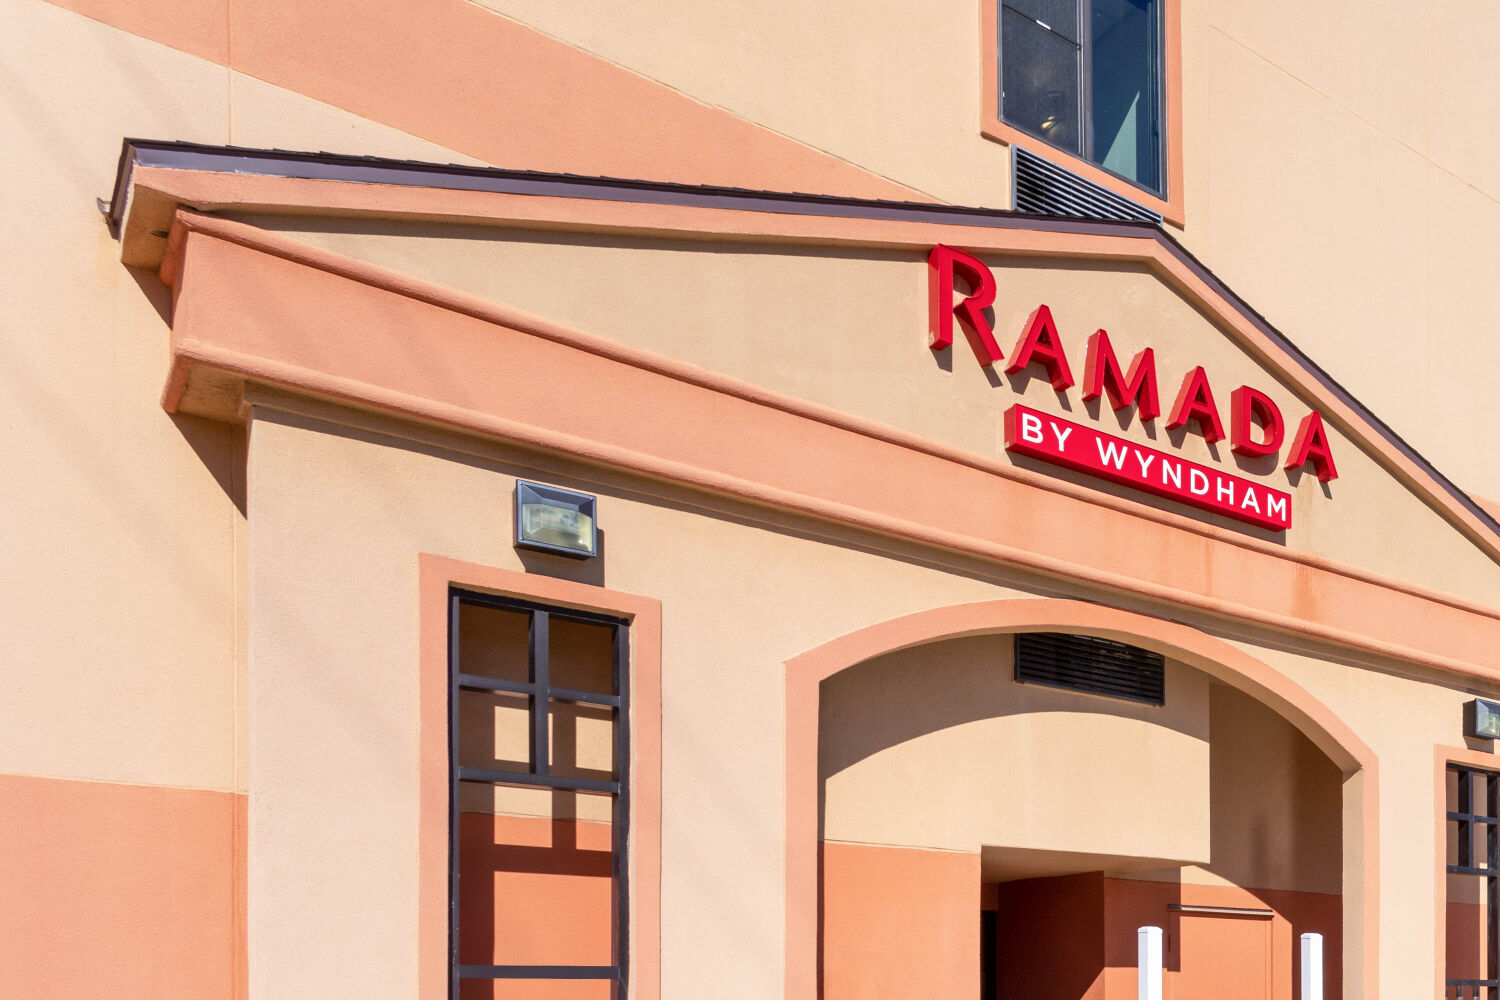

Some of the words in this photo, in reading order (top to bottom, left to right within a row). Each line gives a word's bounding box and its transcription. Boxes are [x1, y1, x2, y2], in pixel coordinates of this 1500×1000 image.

[928, 243, 1339, 484] RAMADA
[1021, 412, 1073, 452] BY
[1094, 436, 1287, 522] WYNDHAM
